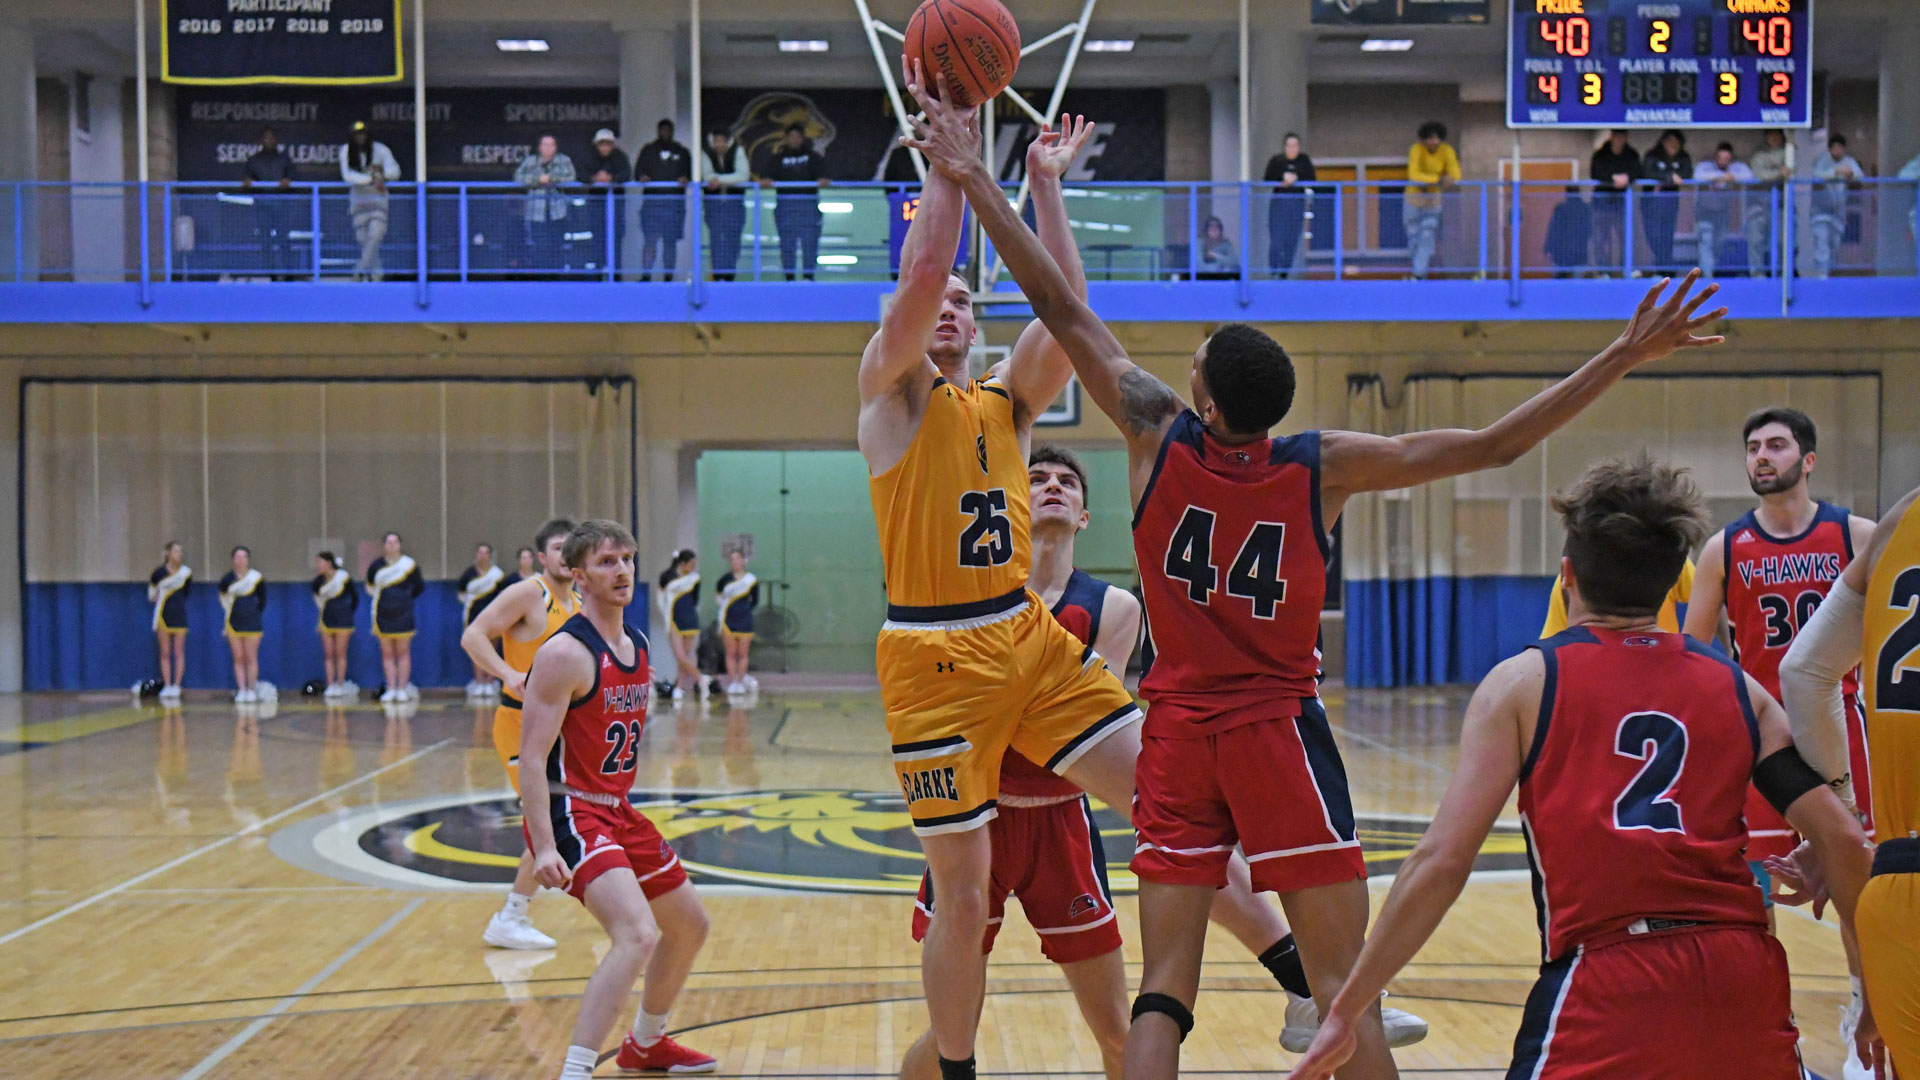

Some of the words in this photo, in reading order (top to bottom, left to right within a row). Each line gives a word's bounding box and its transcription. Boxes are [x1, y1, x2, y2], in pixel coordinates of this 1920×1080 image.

[228, 0, 332, 12] PARTICIPANT
[1536, 0, 1584, 13] PRIDE
[1637, 5, 1681, 18] PERIOD
[179, 19, 221, 34] 2016
[233, 18, 275, 33] 2017
[286, 18, 329, 33] 2018
[341, 18, 383, 33] 2019
[1541, 17, 1590, 56] 40
[1650, 21, 1670, 53] 2
[1743, 17, 1791, 56] 40
[1524, 59, 1563, 73] FOULS
[1619, 59, 1665, 73] PLAYER
[1669, 59, 1700, 73] FOUL
[1756, 58, 1795, 73] FOULS
[1538, 75, 1558, 103] 4
[1583, 73, 1601, 105] 3
[1720, 72, 1737, 105] 3
[1770, 72, 1789, 105] 2
[191, 103, 318, 121] RESPONSIBILITY
[372, 103, 450, 121] INTEGITY
[505, 103, 619, 122] SPORTSMANSH
[1624, 109, 1693, 122] ADVANTAGE
[462, 145, 532, 163] RESPECT
[958, 487, 1015, 569] 25
[1164, 504, 1288, 621] 44
[1737, 553, 1841, 589] V-HAWKS
[600, 719, 641, 775] 23
[1614, 710, 1689, 835] 2
